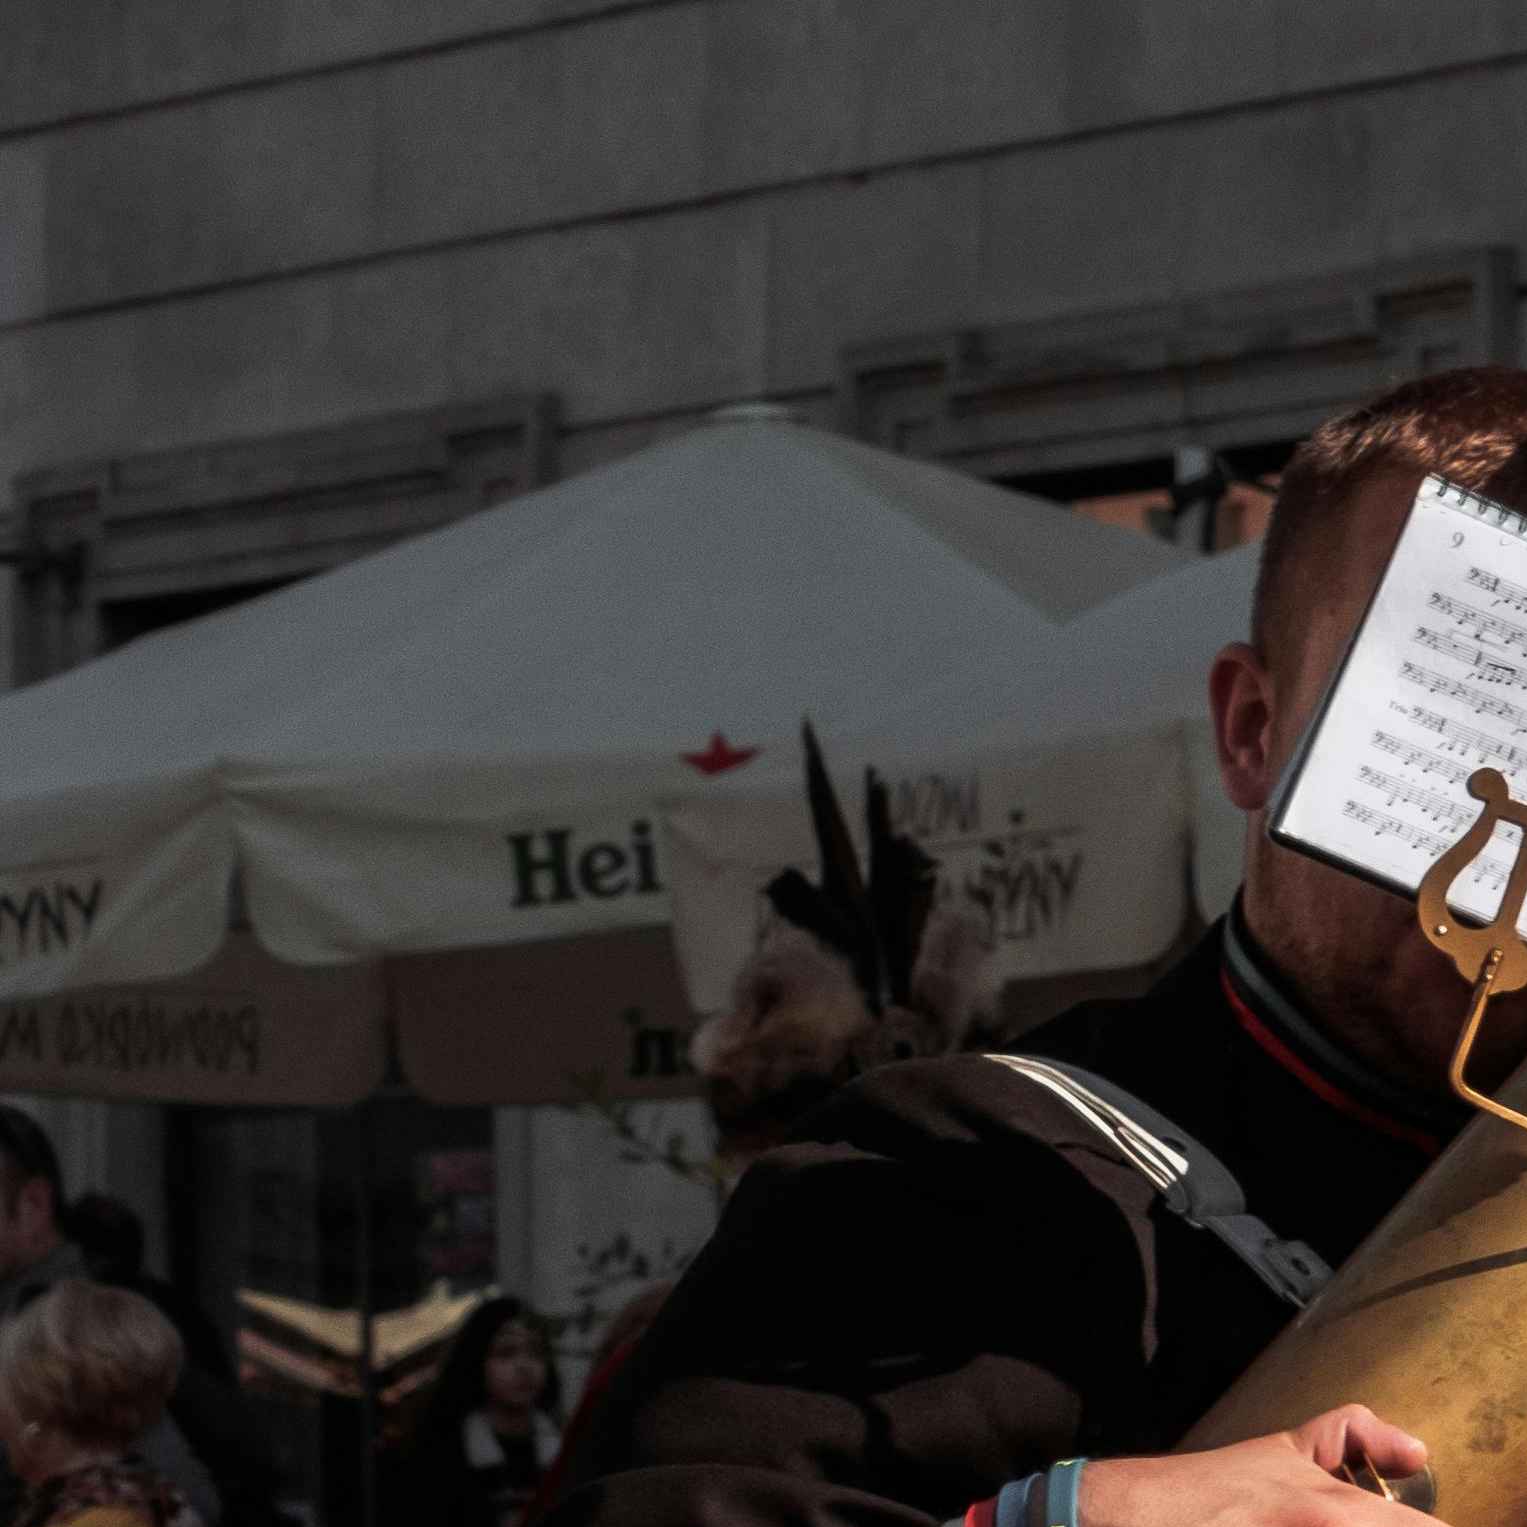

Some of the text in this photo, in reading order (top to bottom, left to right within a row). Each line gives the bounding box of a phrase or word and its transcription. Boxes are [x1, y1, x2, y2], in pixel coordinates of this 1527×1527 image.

[1448, 531, 1465, 549] 9
[507, 819, 665, 908] Hei
[0, 877, 103, 958] YNY
